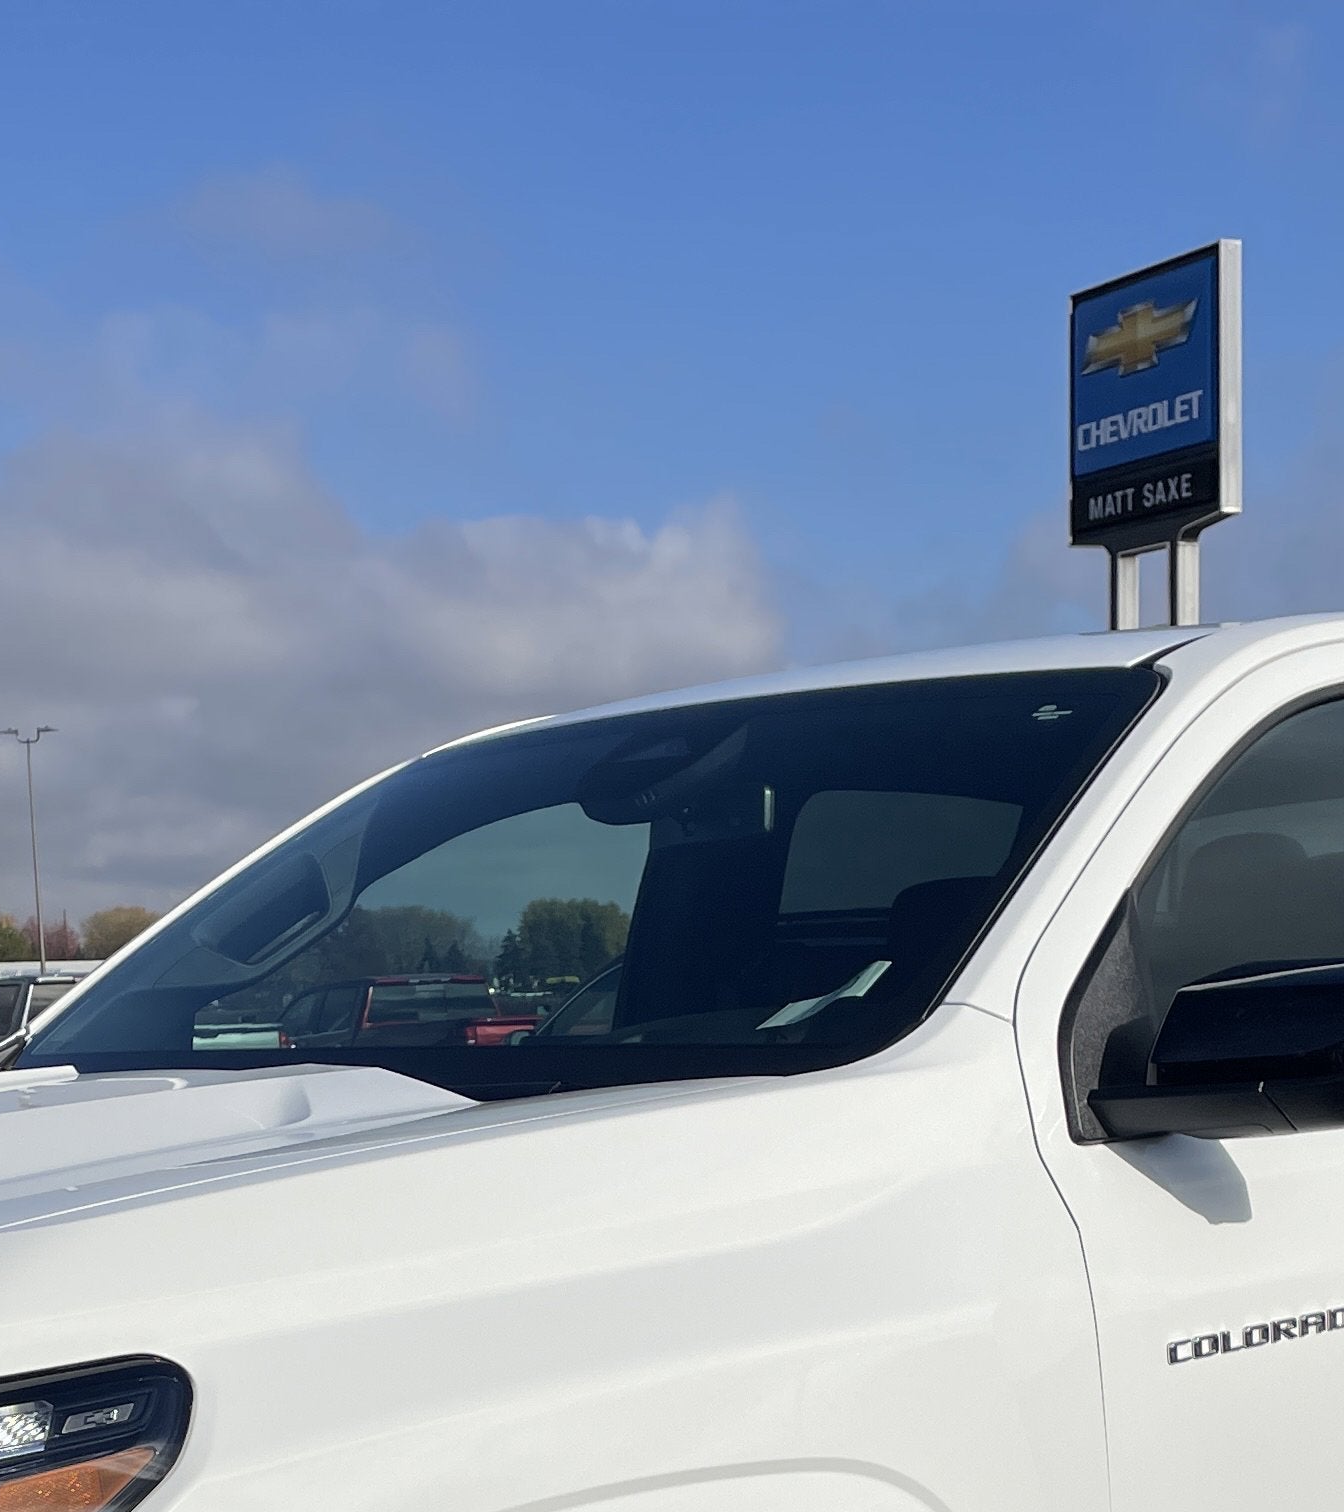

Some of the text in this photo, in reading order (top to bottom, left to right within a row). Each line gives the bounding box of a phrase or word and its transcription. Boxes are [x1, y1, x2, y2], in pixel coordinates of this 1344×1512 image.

[1078, 389, 1204, 451] CHEVROLET
[1089, 473, 1193, 520] MATT SAXE
